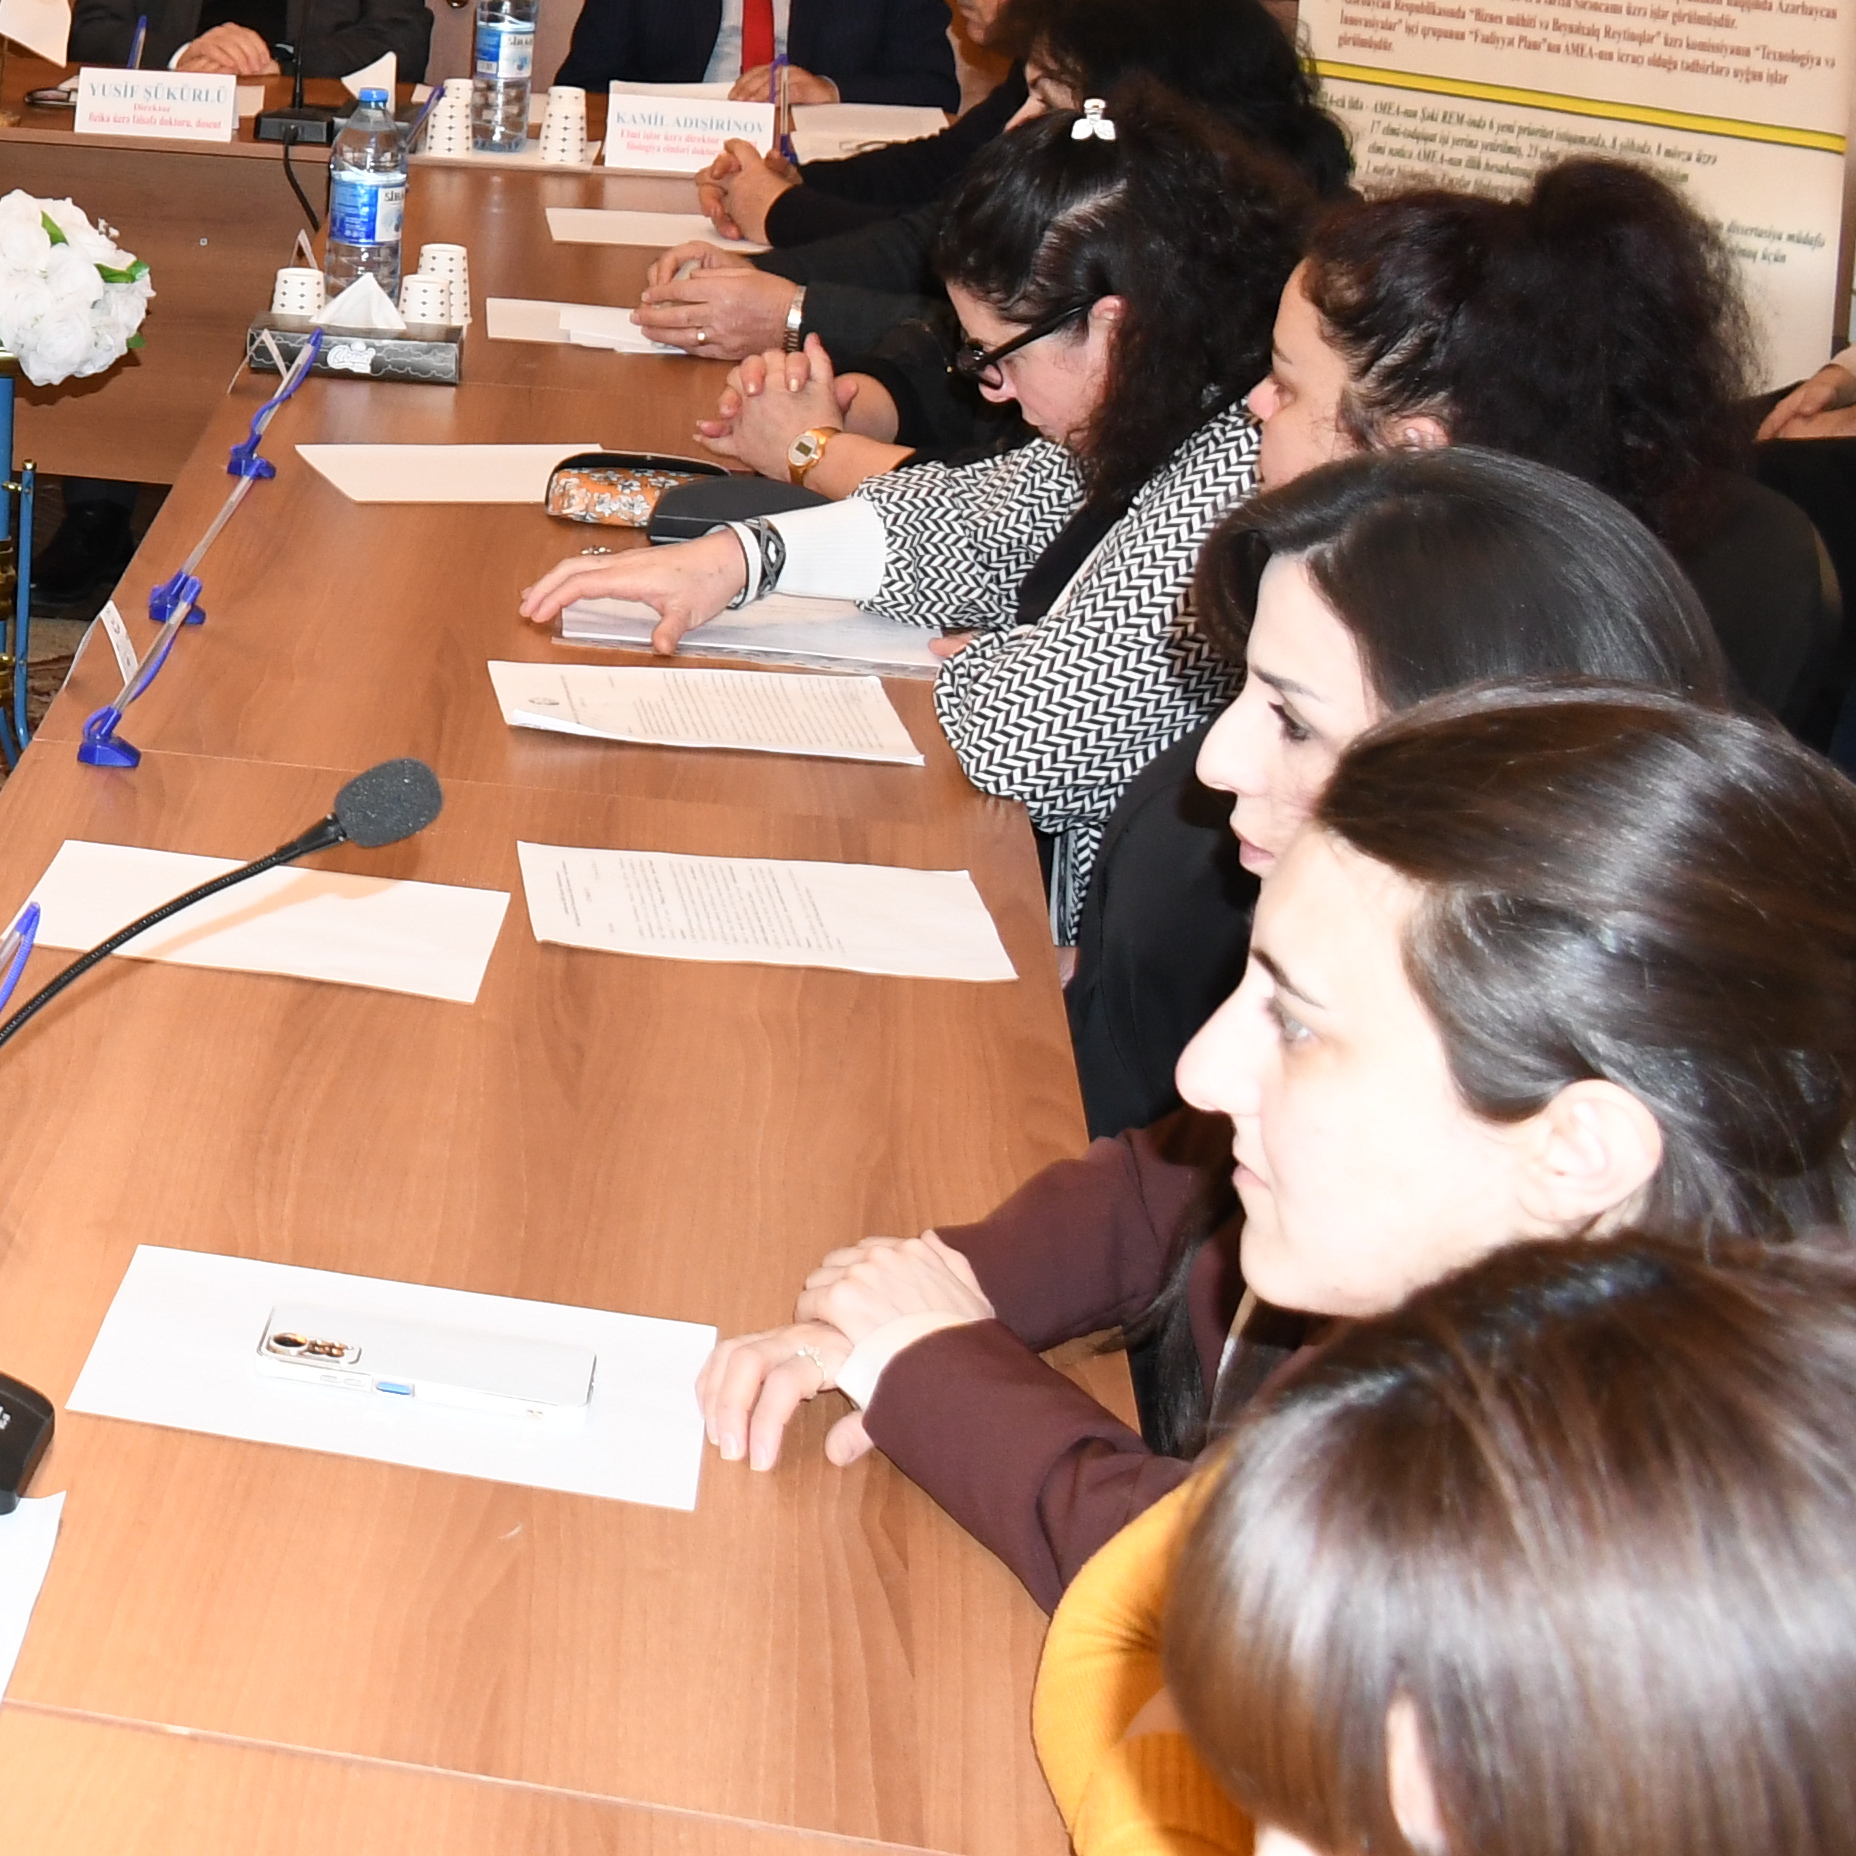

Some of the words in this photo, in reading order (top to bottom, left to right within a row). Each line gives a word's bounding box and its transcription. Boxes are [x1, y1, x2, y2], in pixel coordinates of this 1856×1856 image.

[88, 81, 139, 99] YUSİF
[144, 82, 228, 104] ŞÜKÜRLÜ
[616, 111, 667, 127] KAMİL
